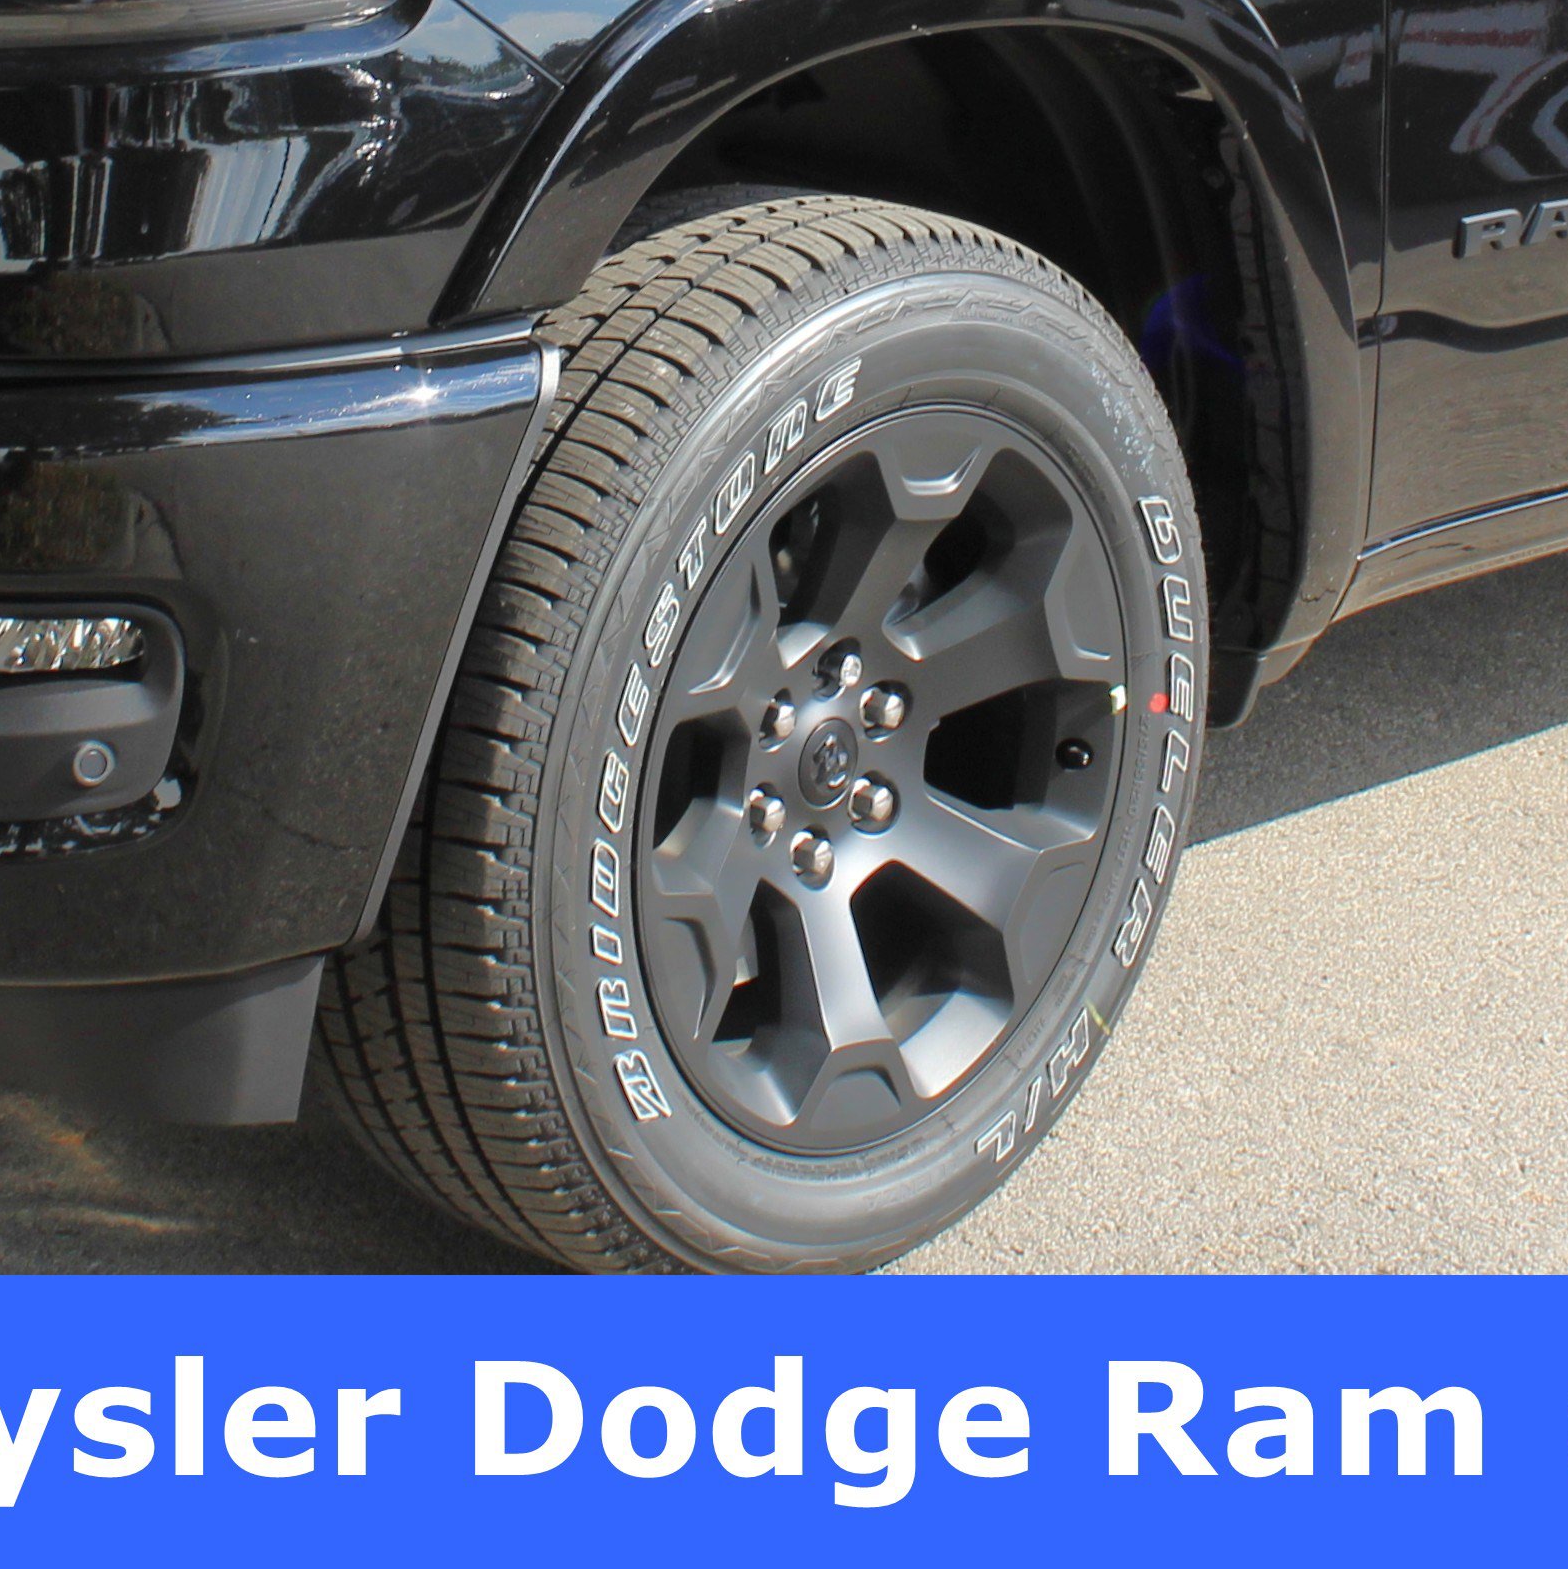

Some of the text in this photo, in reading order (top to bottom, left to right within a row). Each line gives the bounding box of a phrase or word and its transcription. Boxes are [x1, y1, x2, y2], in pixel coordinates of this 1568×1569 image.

[590, 356, 862, 1122] BRIDGESTONE
[1112, 495, 1195, 968] DUELER
[974, 1006, 1090, 1163] H/L
